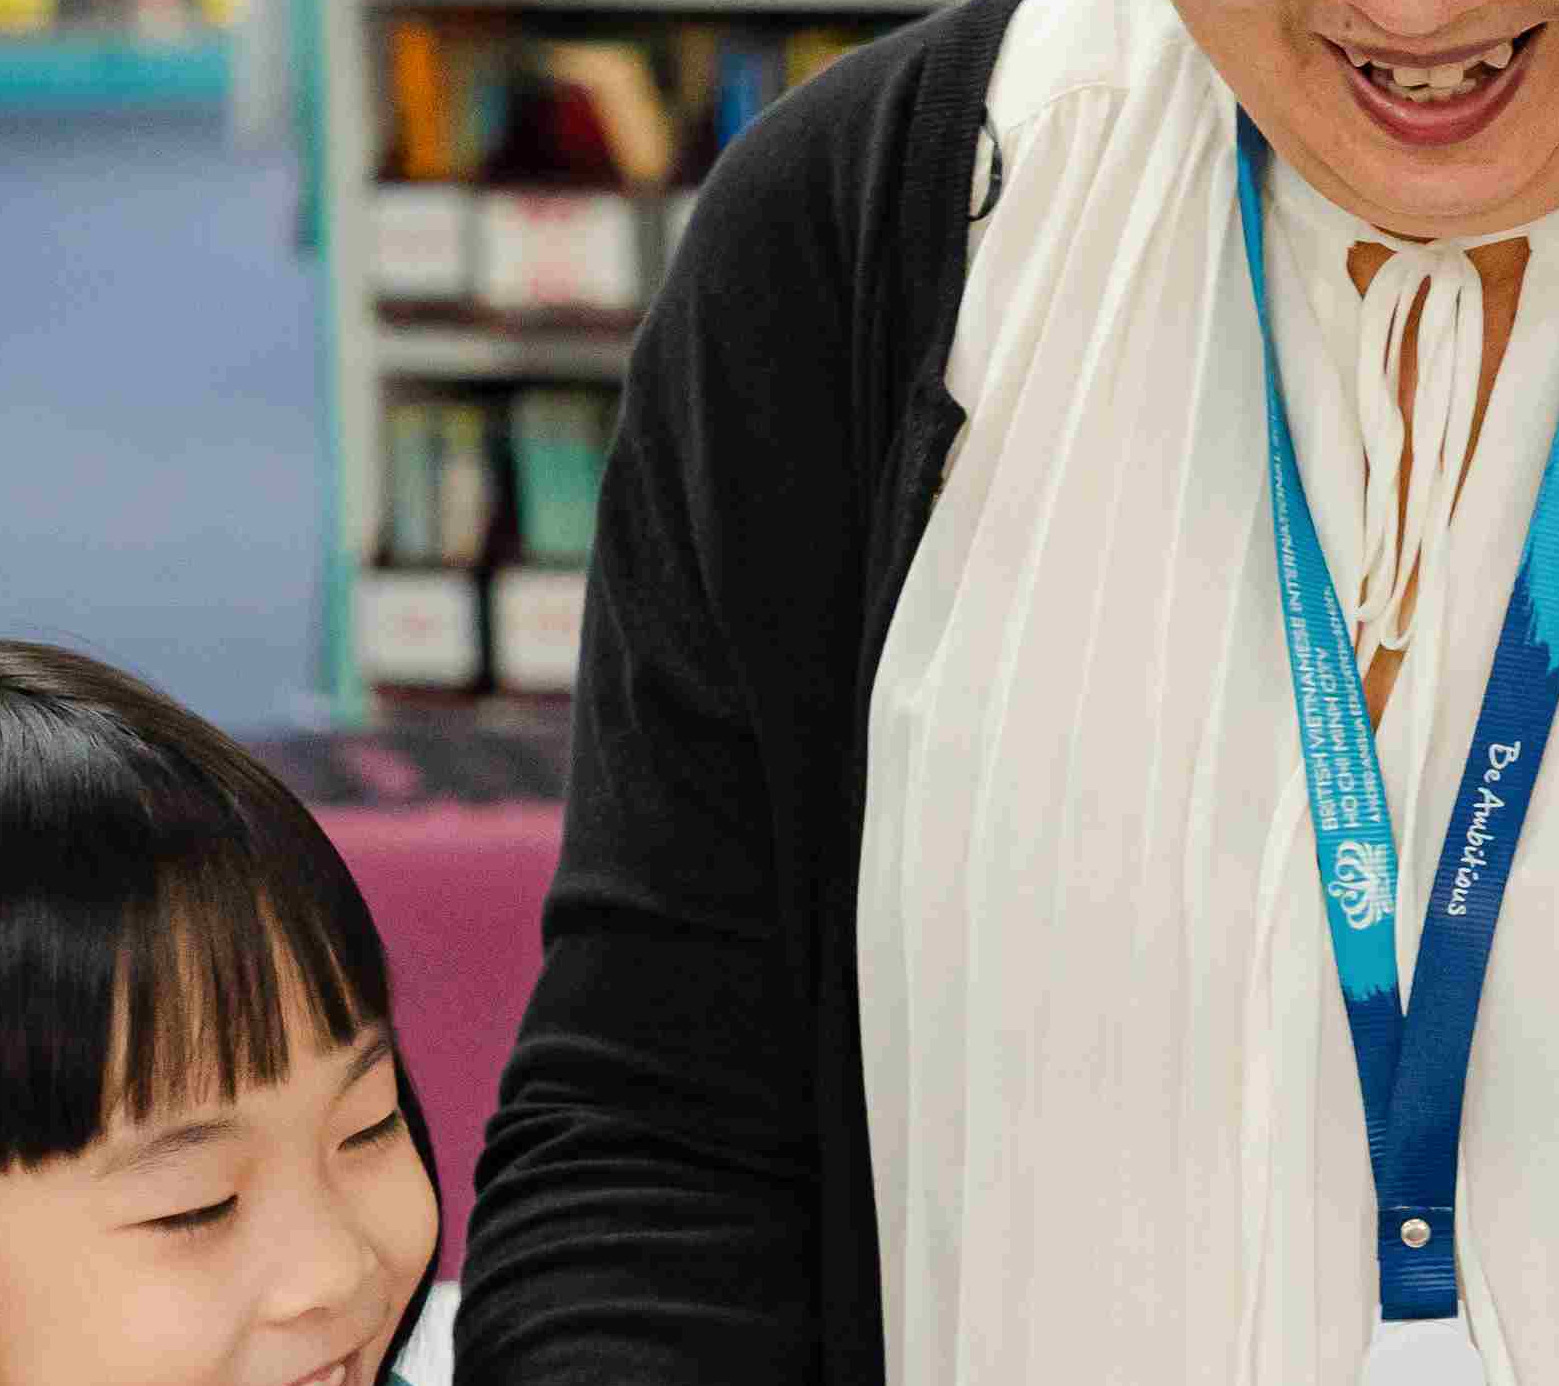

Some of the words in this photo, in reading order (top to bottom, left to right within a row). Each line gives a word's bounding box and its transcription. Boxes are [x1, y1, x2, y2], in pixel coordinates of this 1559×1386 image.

[1291, 616, 1326, 750] VIETNAMESE
[1315, 646, 1338, 694] CITY
[1324, 697, 1350, 752] MINH
[1335, 757, 1356, 793] CHI
[1482, 740, 1522, 784] Be
[1311, 752, 1339, 830] BRITISH
[1342, 795, 1363, 828] HO
[1447, 786, 1506, 916] Ambitious
